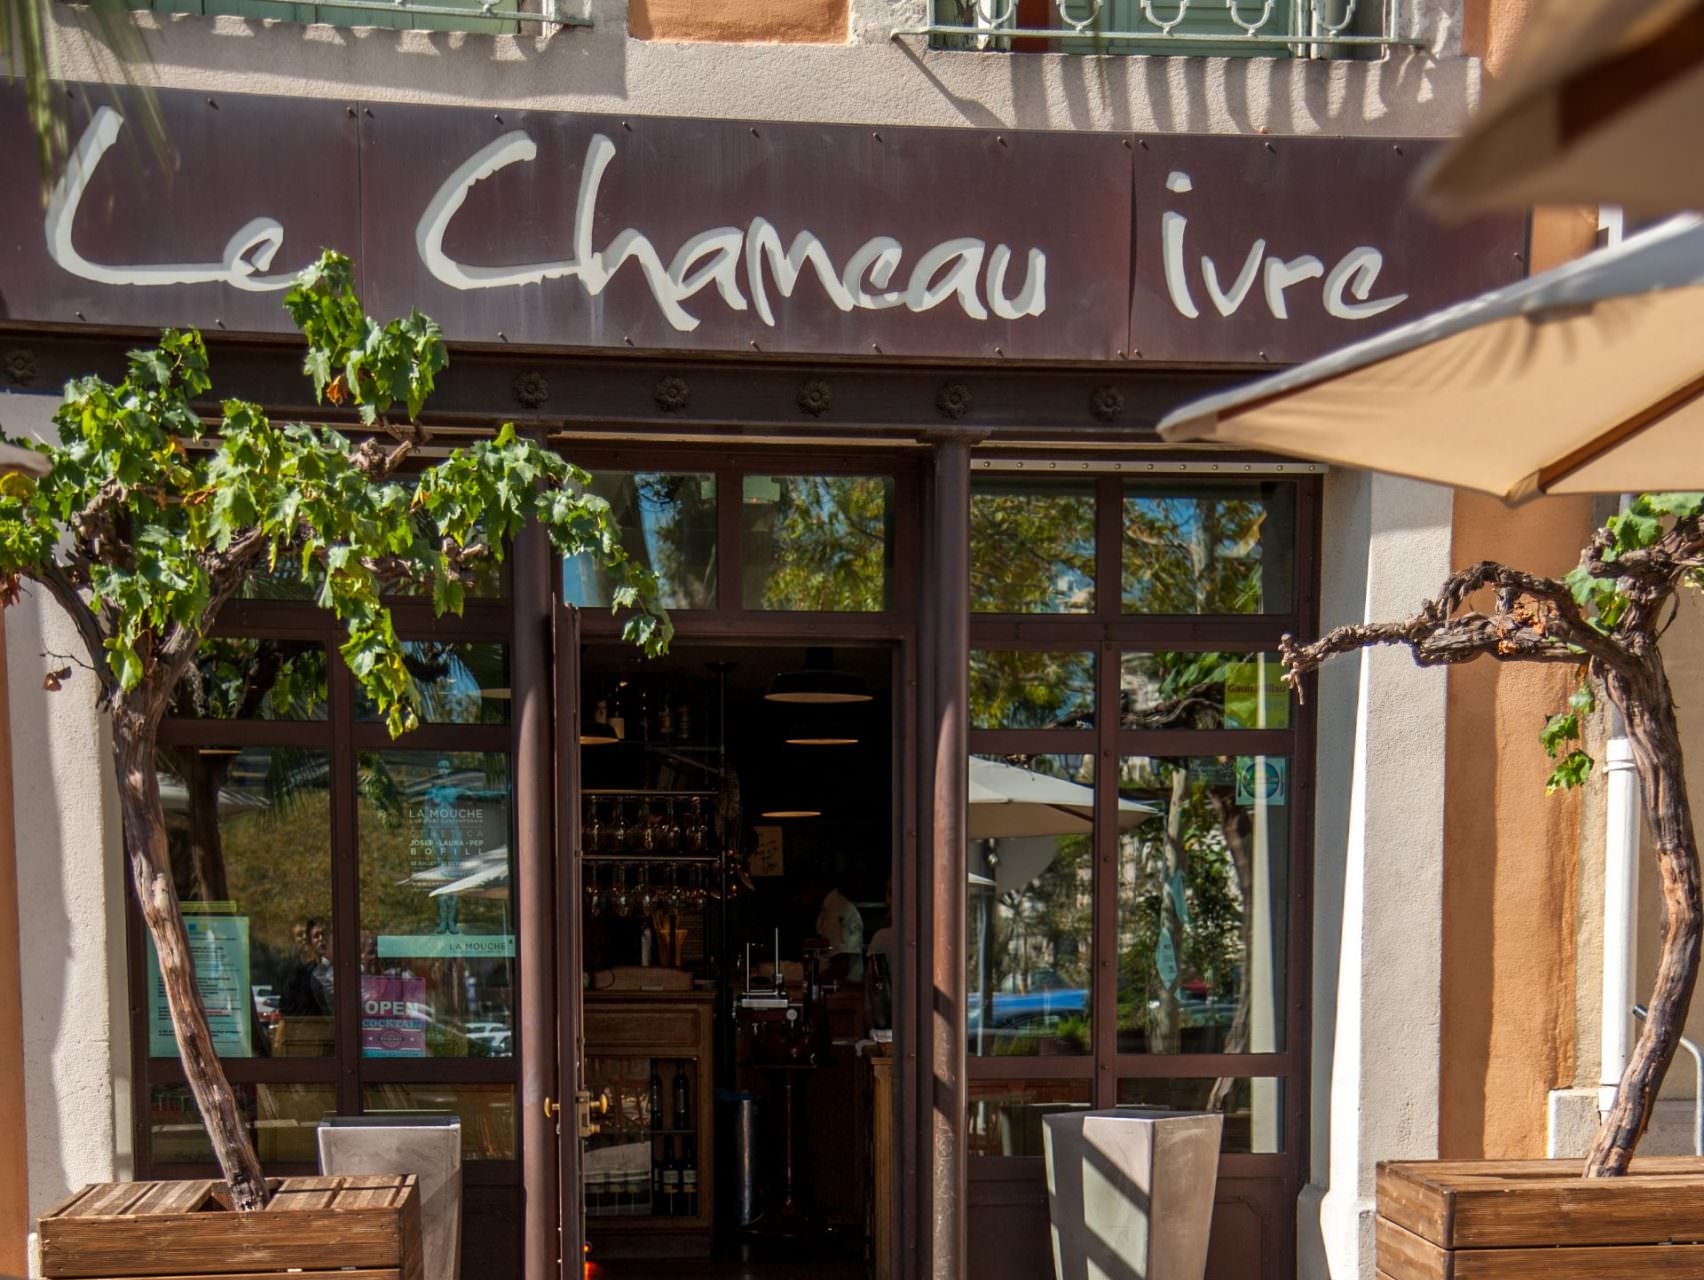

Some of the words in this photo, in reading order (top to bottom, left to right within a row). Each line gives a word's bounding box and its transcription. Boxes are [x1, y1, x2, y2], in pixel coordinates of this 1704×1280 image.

[45, 105, 297, 292] Le
[415, 128, 1046, 332] Chameau
[1161, 170, 1409, 320] ivre
[409, 809, 424, 818] LA
[430, 809, 484, 818] MOUCHE
[449, 943, 462, 951] LA
[465, 943, 506, 951] MOUCHE
[364, 1000, 419, 1016] OPEN
